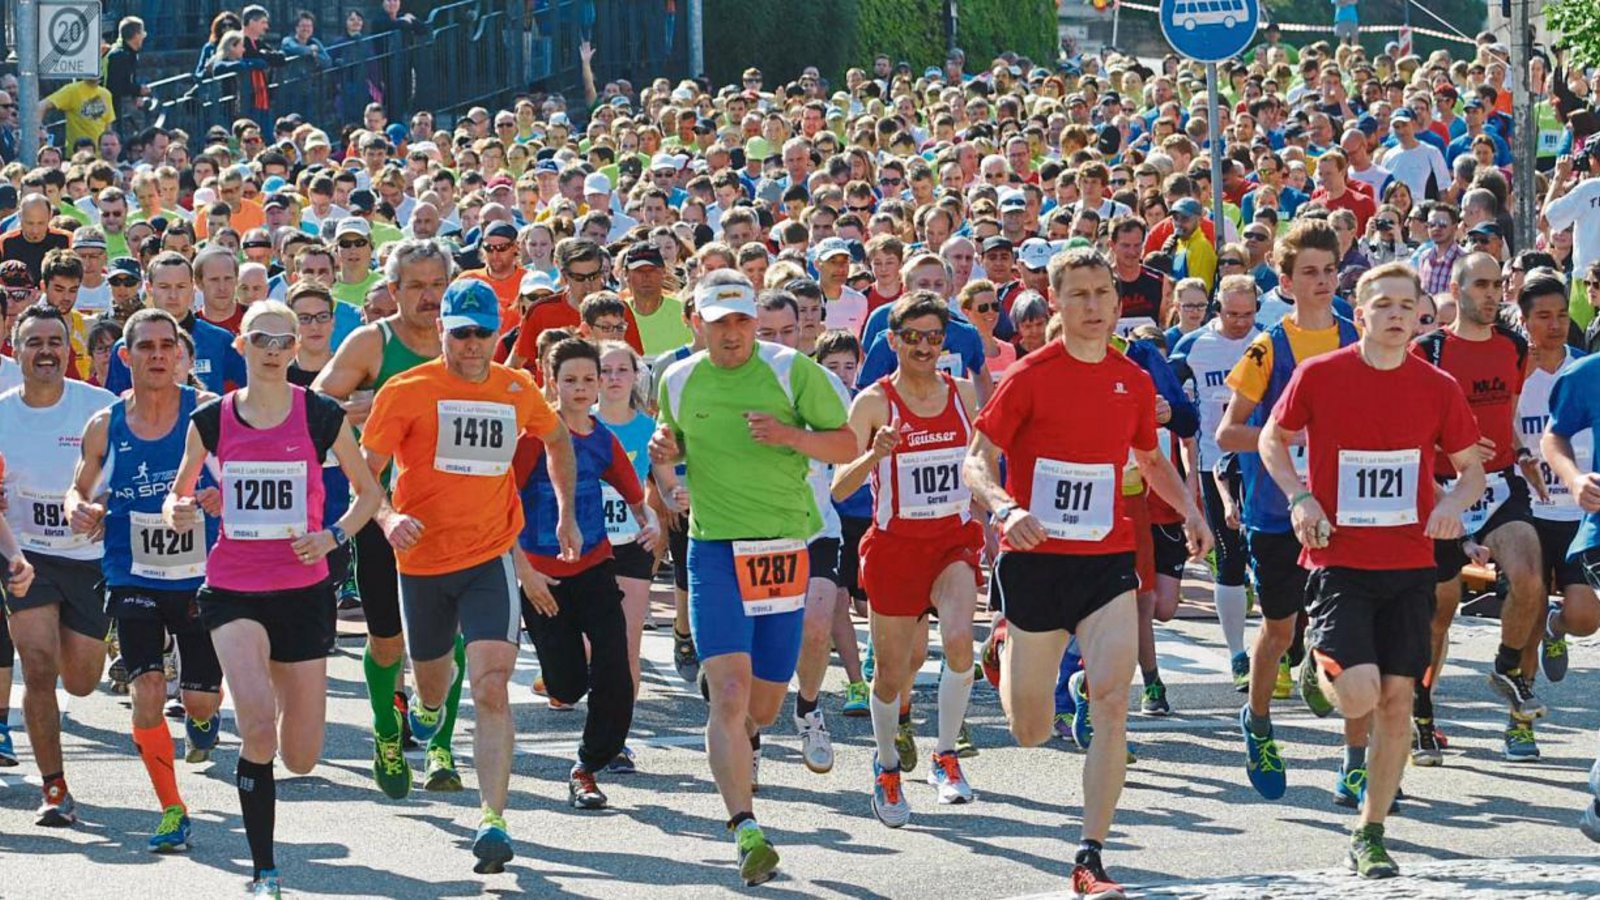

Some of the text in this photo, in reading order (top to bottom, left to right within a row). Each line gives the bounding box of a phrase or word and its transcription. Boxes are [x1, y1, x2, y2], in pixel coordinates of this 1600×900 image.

[58, 20, 81, 43] 20
[53, 60, 84, 72] ZONE
[453, 417, 503, 448] 1418
[908, 430, 957, 447] Teusser
[911, 463, 960, 494] 1021
[1356, 467, 1403, 498] 1121
[234, 479, 293, 510] 1206
[1055, 480, 1093, 511] 911
[141, 528, 193, 555] 1420
[746, 553, 797, 587] 1287
